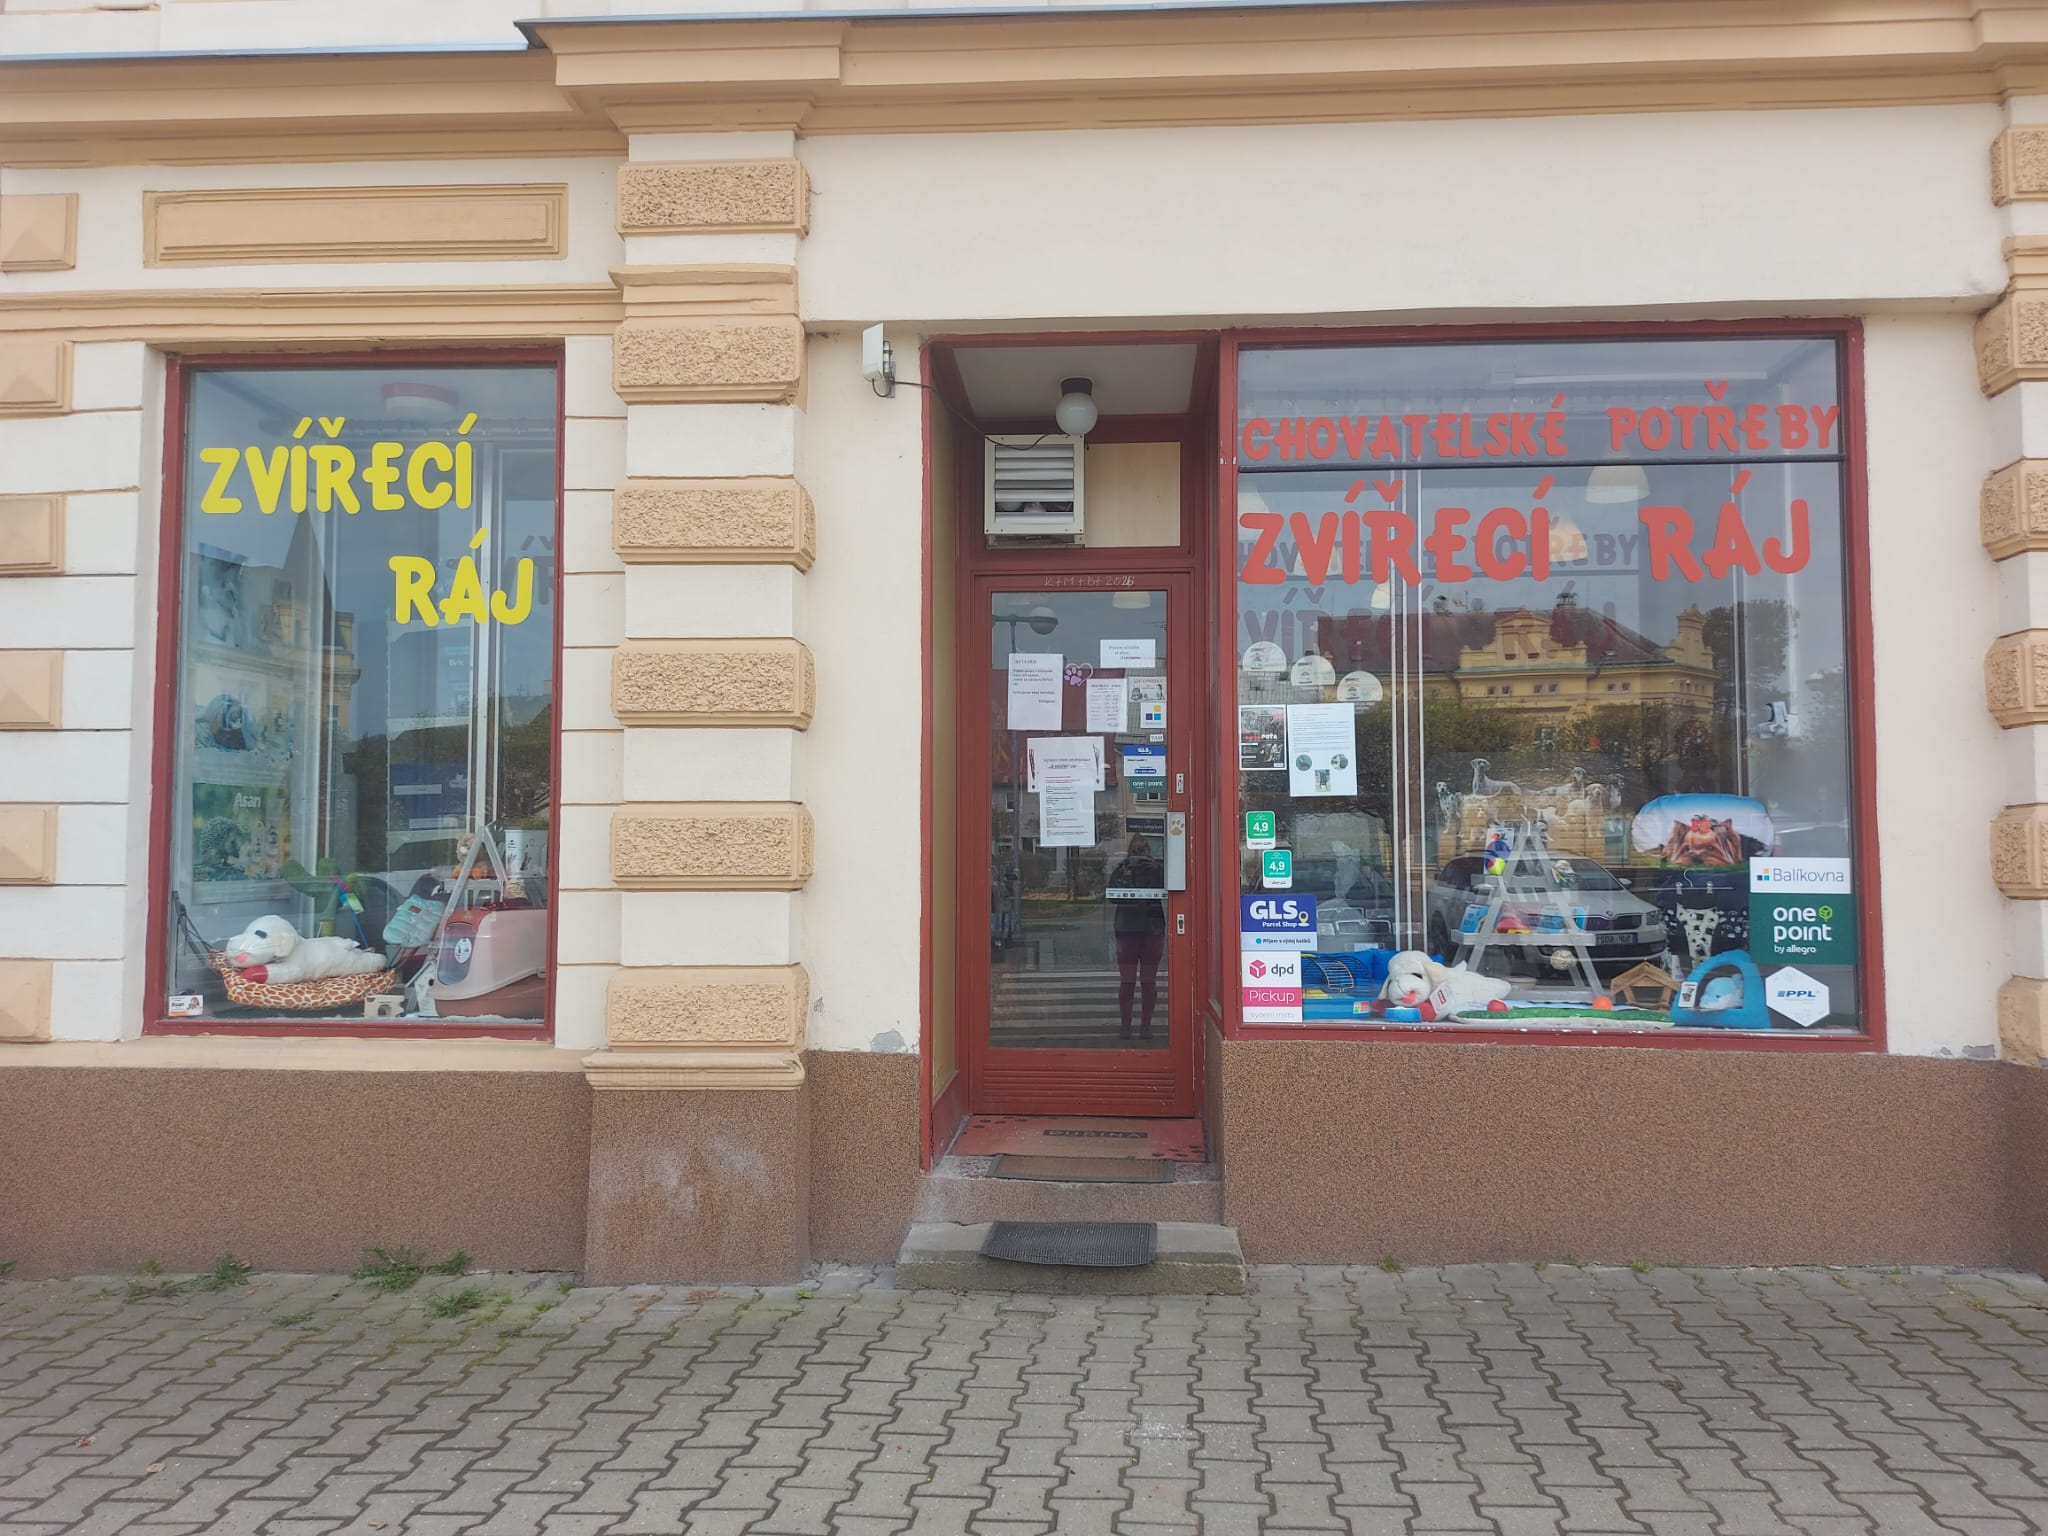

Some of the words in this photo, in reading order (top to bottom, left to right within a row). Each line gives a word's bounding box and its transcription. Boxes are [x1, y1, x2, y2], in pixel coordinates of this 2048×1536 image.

[1242, 393, 1567, 460] CHOVATELSKÉ
[1608, 381, 1839, 452] POTŘEBY
[200, 413, 478, 514] ZVÍŘECÍ
[1240, 476, 1555, 586] ZVÍŘECÍ
[1639, 470, 1810, 582] RÁJ
[389, 528, 534, 626] RÁJ
[234, 792, 261, 808] Asan
[1253, 821, 1269, 832] 4,9
[1269, 860, 1286, 872] 4,9
[1773, 867, 1845, 883] Balíkovna
[1249, 900, 1298, 920] GLS
[1773, 907, 1817, 922] one
[1774, 924, 1833, 943] point
[1774, 944, 1785, 954] by
[1786, 944, 1817, 955] allegro
[1271, 963, 1294, 977] dpd
[1249, 990, 1295, 1003] Pickup
[1786, 990, 1816, 998] PPL
